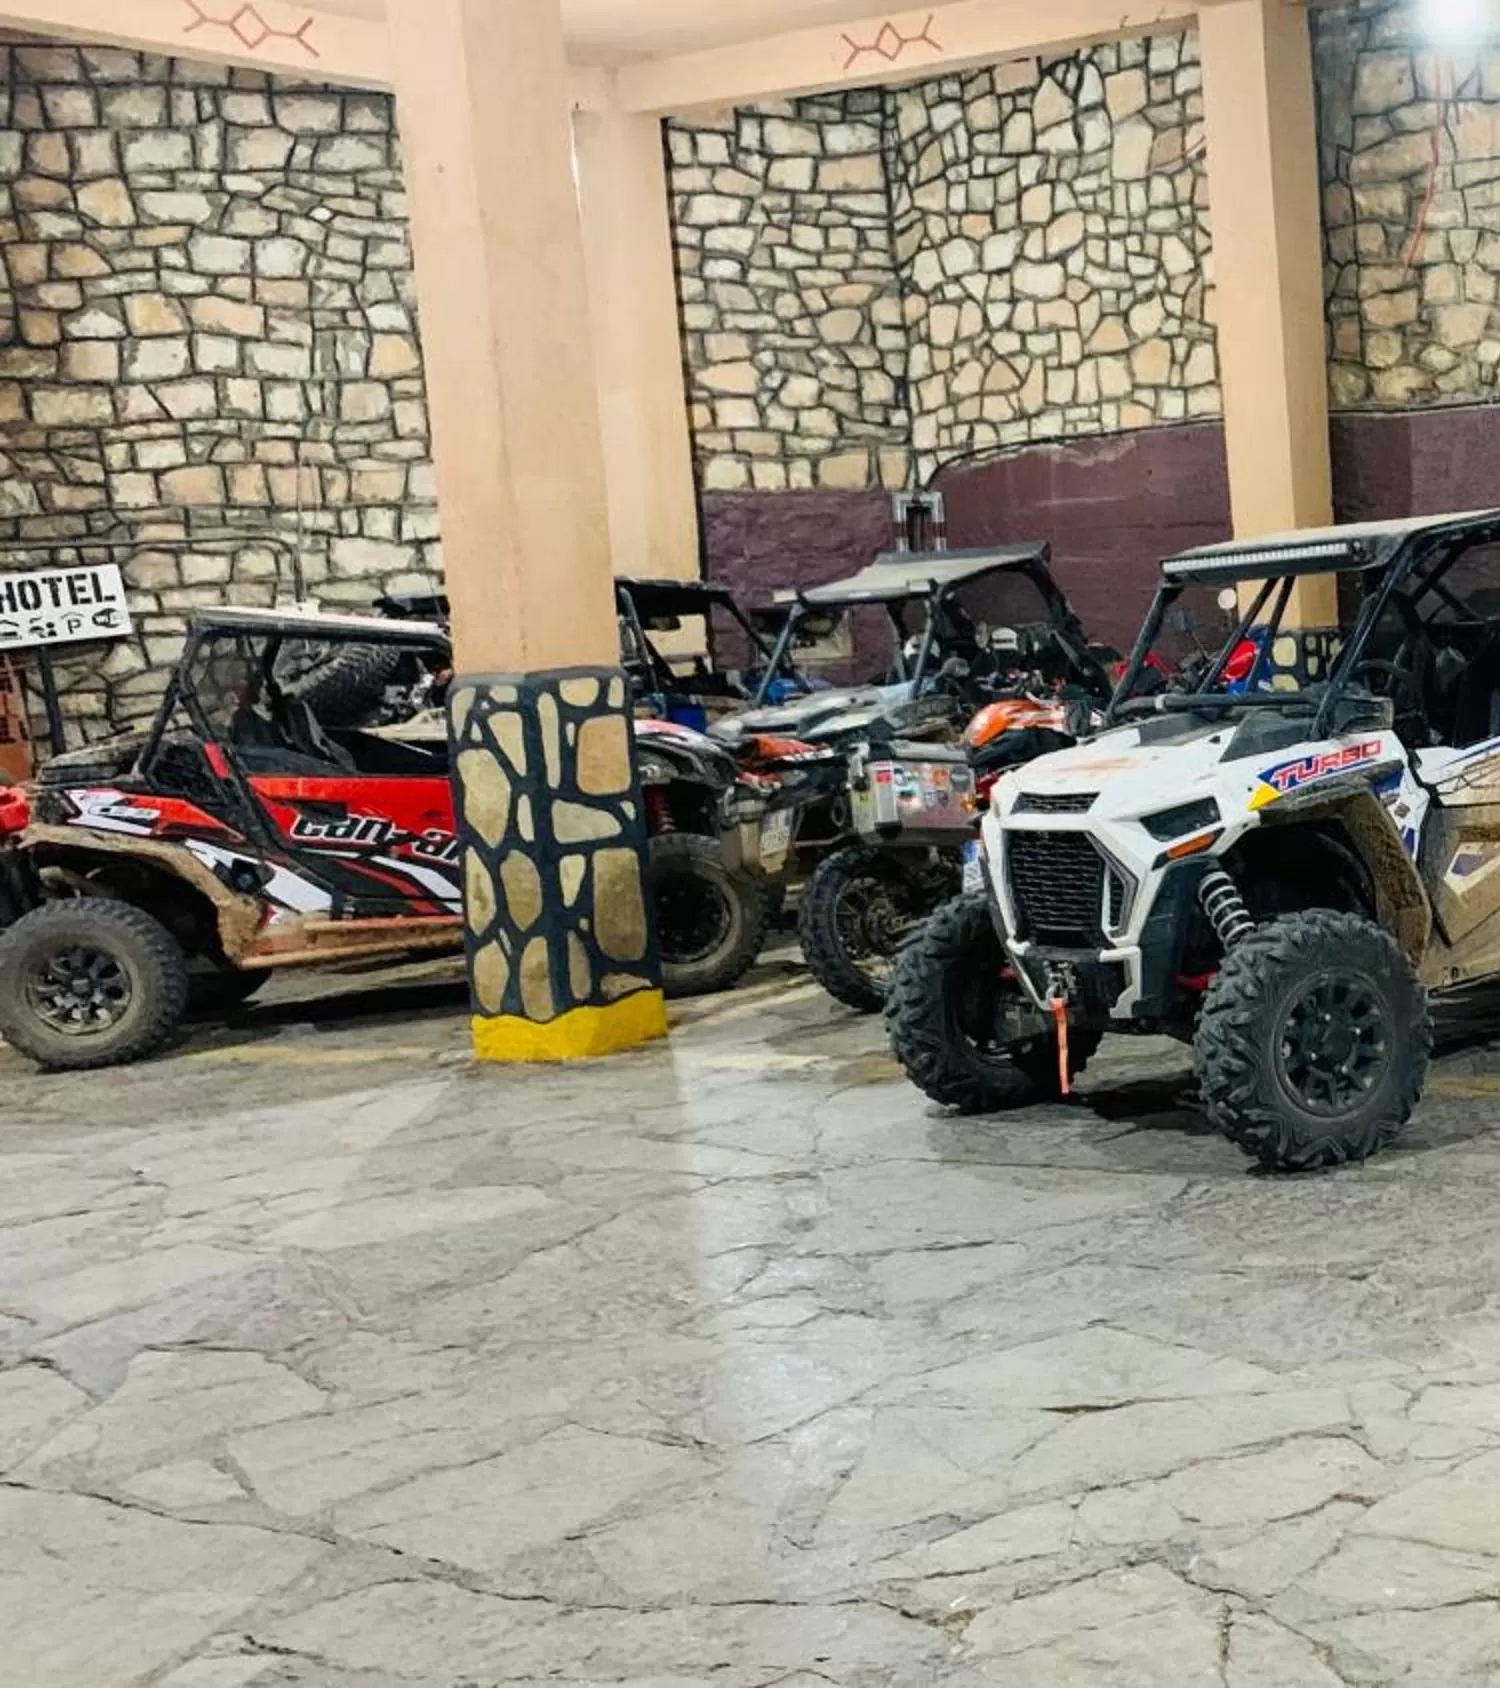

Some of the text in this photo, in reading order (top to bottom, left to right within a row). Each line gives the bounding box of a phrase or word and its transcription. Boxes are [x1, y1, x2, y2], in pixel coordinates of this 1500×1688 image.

[0, 571, 117, 614] HOTEL
[1271, 739, 1384, 789] TURBO
[290, 812, 461, 865] can-a
